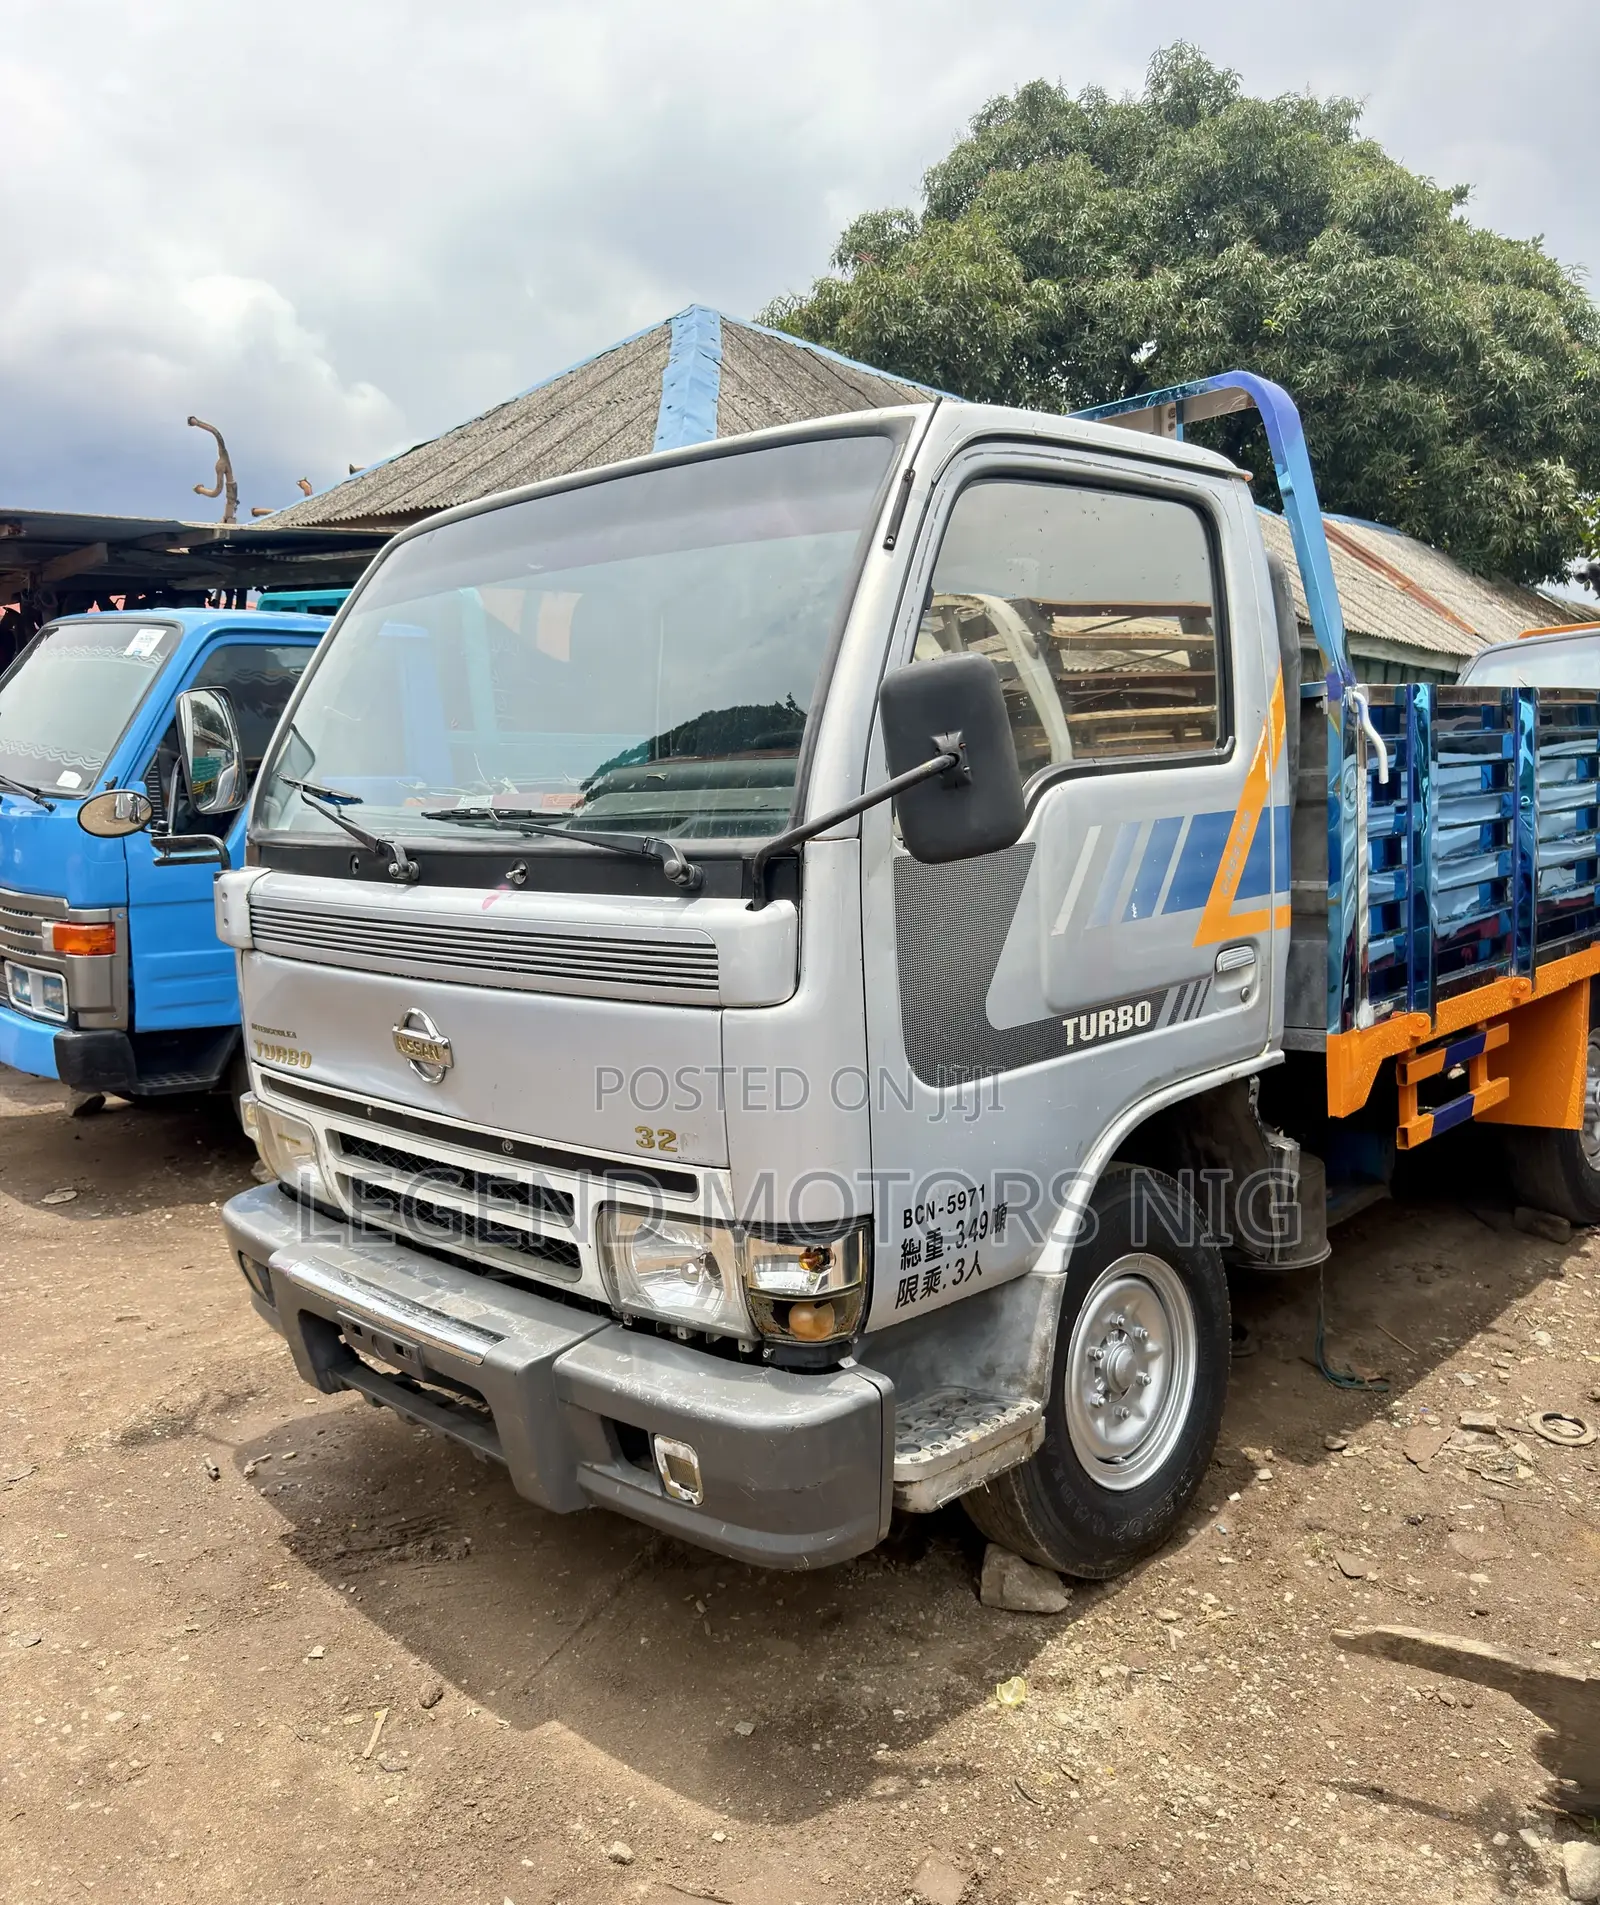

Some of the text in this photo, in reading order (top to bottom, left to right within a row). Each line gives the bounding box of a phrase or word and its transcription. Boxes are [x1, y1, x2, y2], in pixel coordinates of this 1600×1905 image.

[1062, 1000, 1151, 1046] TURBO
[253, 1039, 312, 1069] TURBO
[396, 1034, 441, 1062] NISSAN
[903, 1184, 985, 1229] BCN-5971
